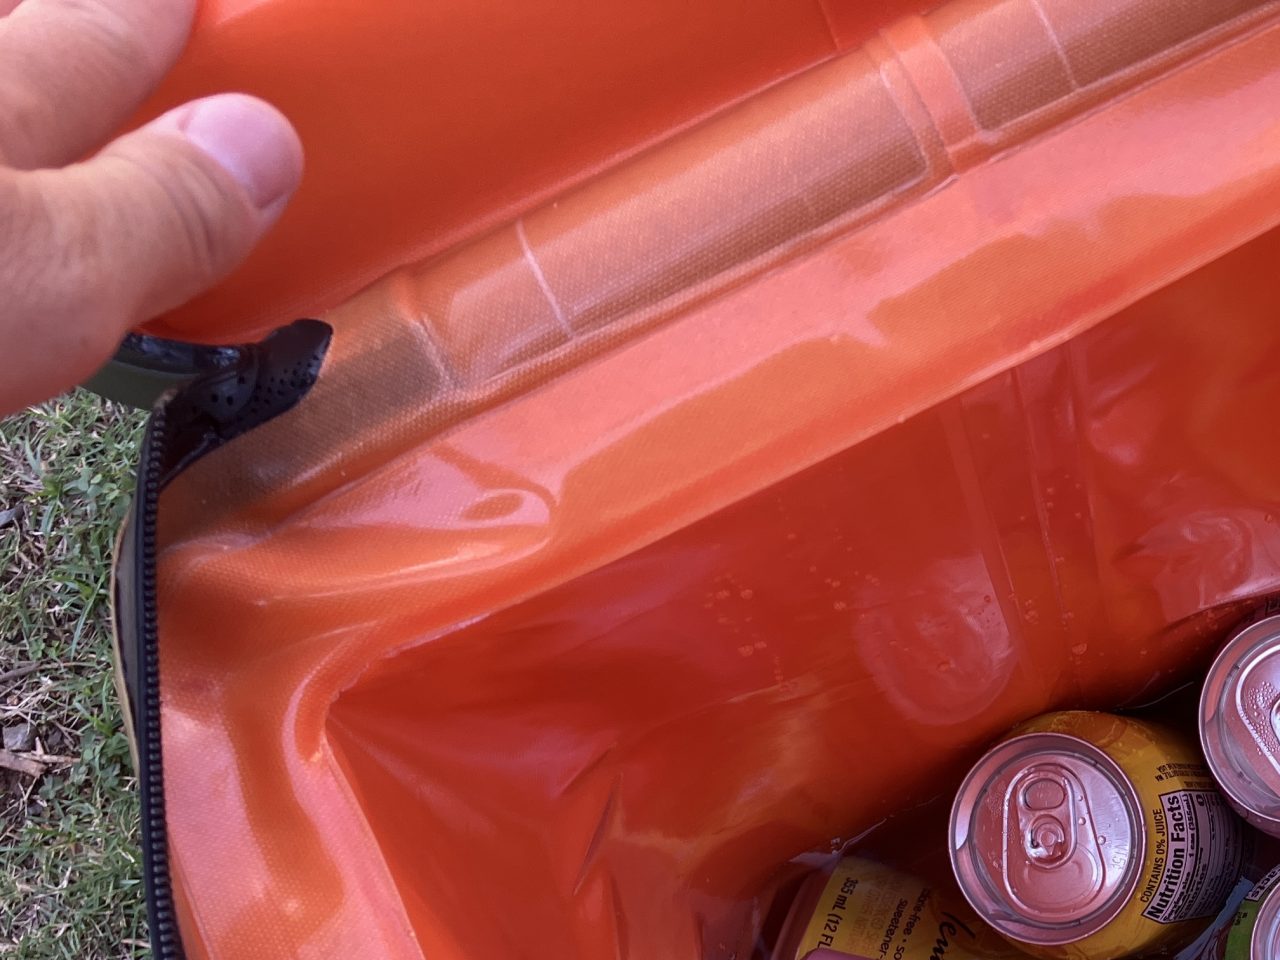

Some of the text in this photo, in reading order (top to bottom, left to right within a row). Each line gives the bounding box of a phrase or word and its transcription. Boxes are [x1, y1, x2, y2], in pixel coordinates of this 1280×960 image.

[1140, 808, 1164, 902] CONTAINS 0% JUICE
[1145, 847, 1185, 918] Nutrition
[1167, 796, 1184, 841] Facts
[839, 877, 858, 895] 355
[831, 894, 848, 912] mL
[823, 912, 843, 933] (12
